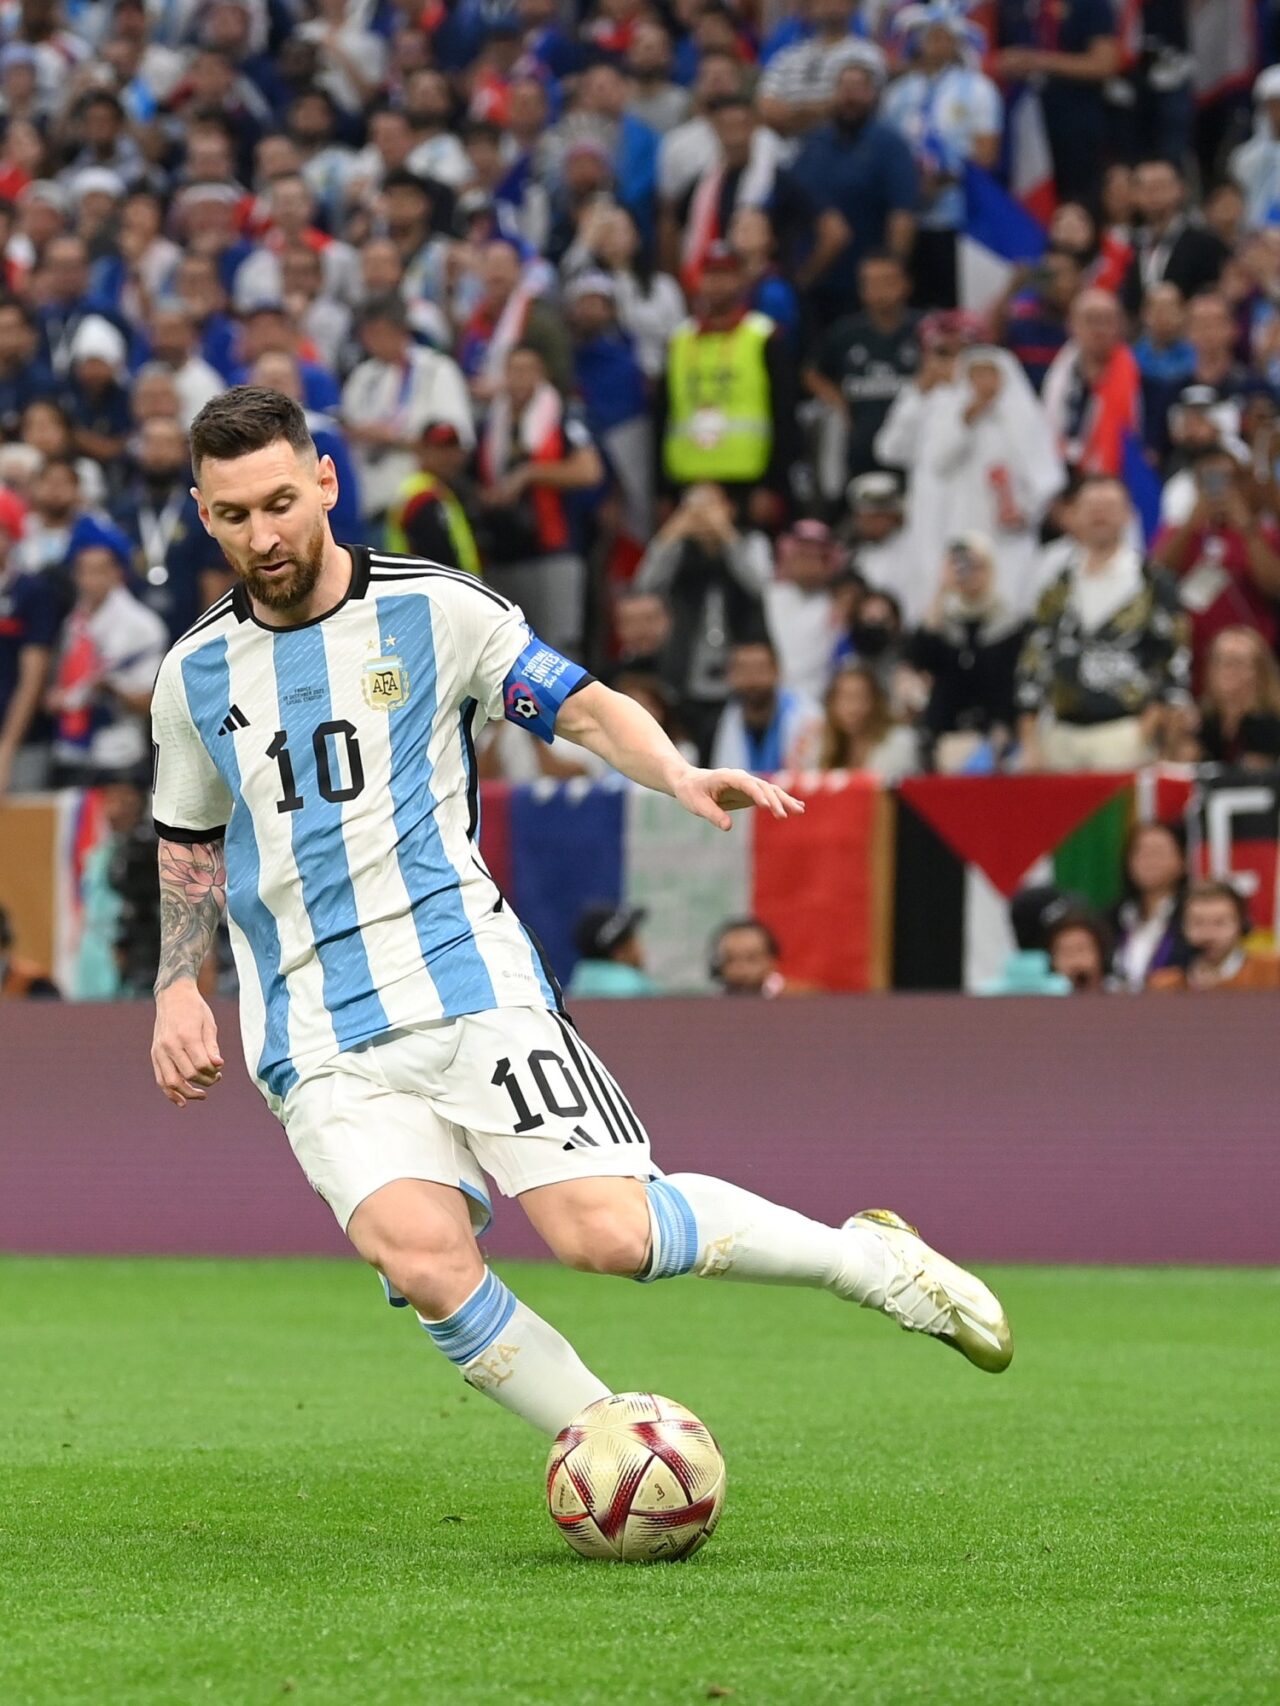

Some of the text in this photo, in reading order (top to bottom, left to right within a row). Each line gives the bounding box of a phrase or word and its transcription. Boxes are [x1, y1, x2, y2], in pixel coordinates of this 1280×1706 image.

[521, 648, 549, 678] FOOTBALL
[529, 652, 561, 684] UNITES
[372, 671, 399, 696] AFA
[265, 719, 366, 815] 10
[490, 1050, 589, 1134] 10
